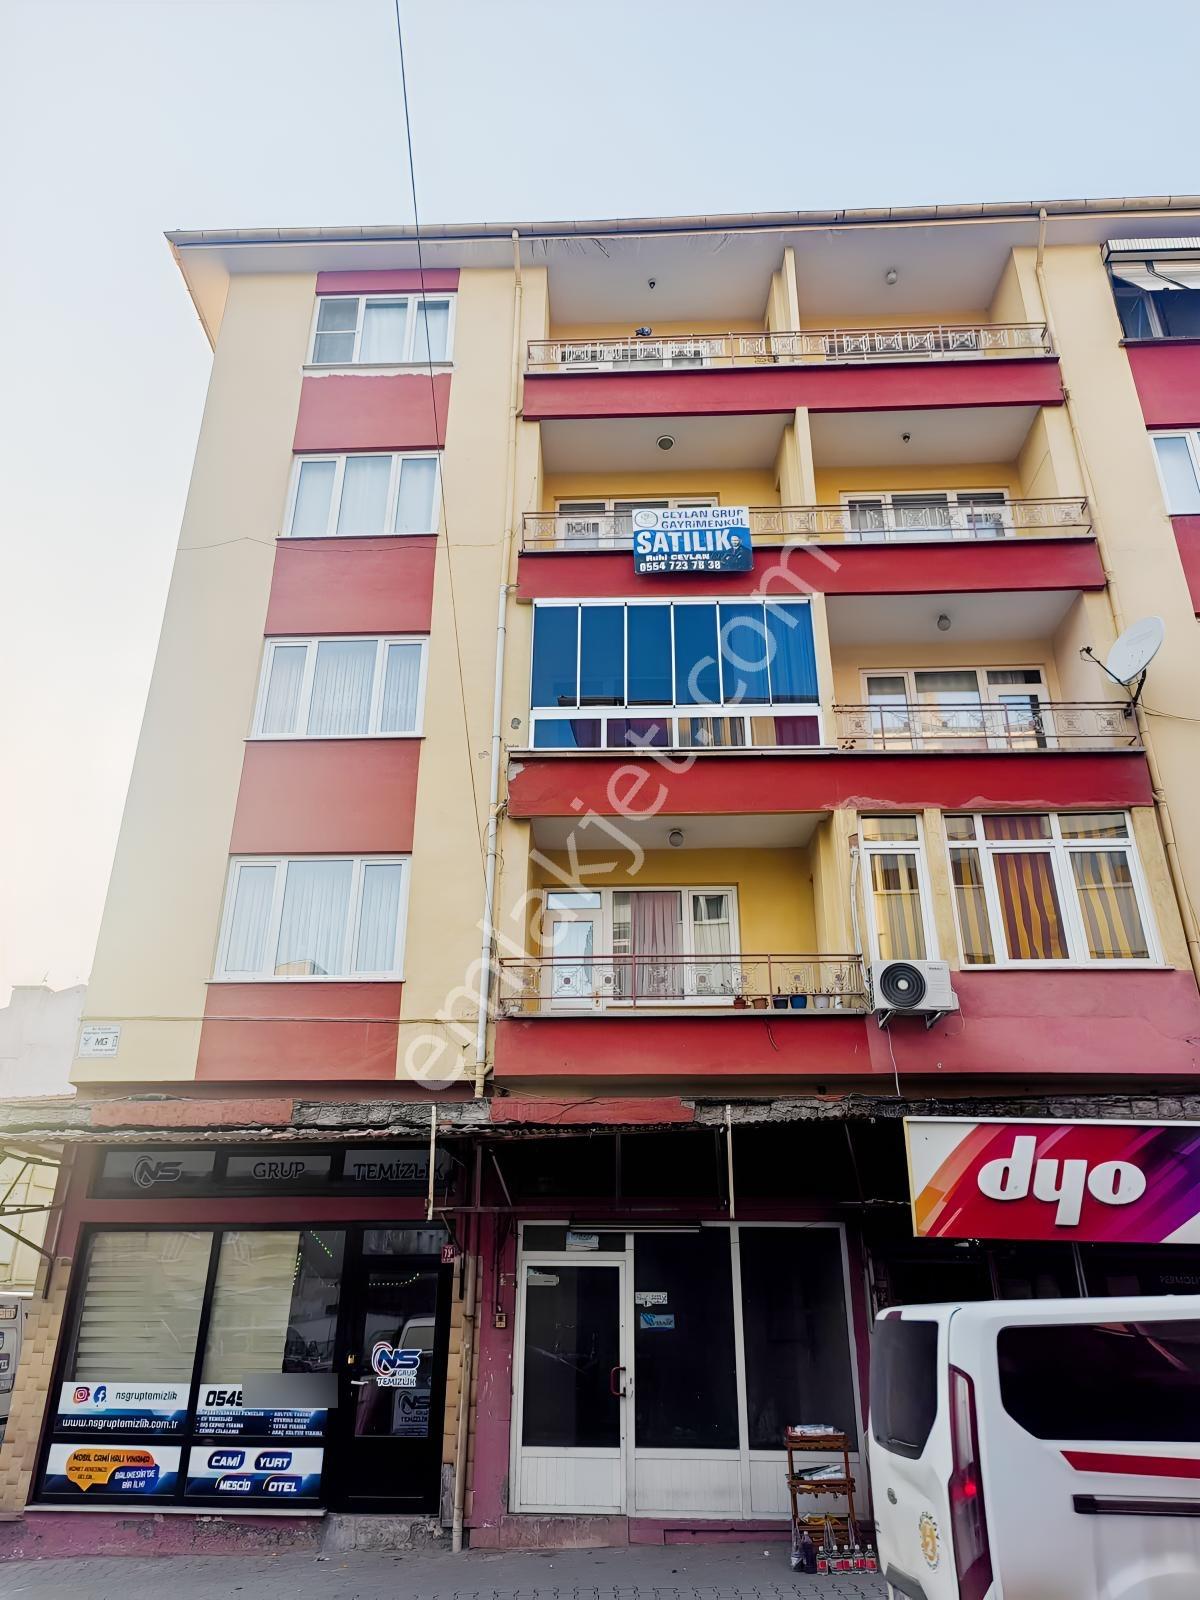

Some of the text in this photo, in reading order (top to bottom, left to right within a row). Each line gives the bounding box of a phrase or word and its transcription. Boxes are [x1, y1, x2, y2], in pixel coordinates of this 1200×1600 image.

[636, 529, 732, 554] SATILIK
[640, 560, 666, 572] 0554
[252, 1161, 306, 1180] GRUP
[977, 1135, 1147, 1226] dyo
[115, 1390, 178, 1402] nsgruptemizlik
[62, 1418, 179, 1430] www.nsgruptemizlik.com.tr
[211, 1454, 242, 1467] CAMİ
[259, 1457, 291, 1468] YURT
[267, 1481, 298, 1492] OTEL
